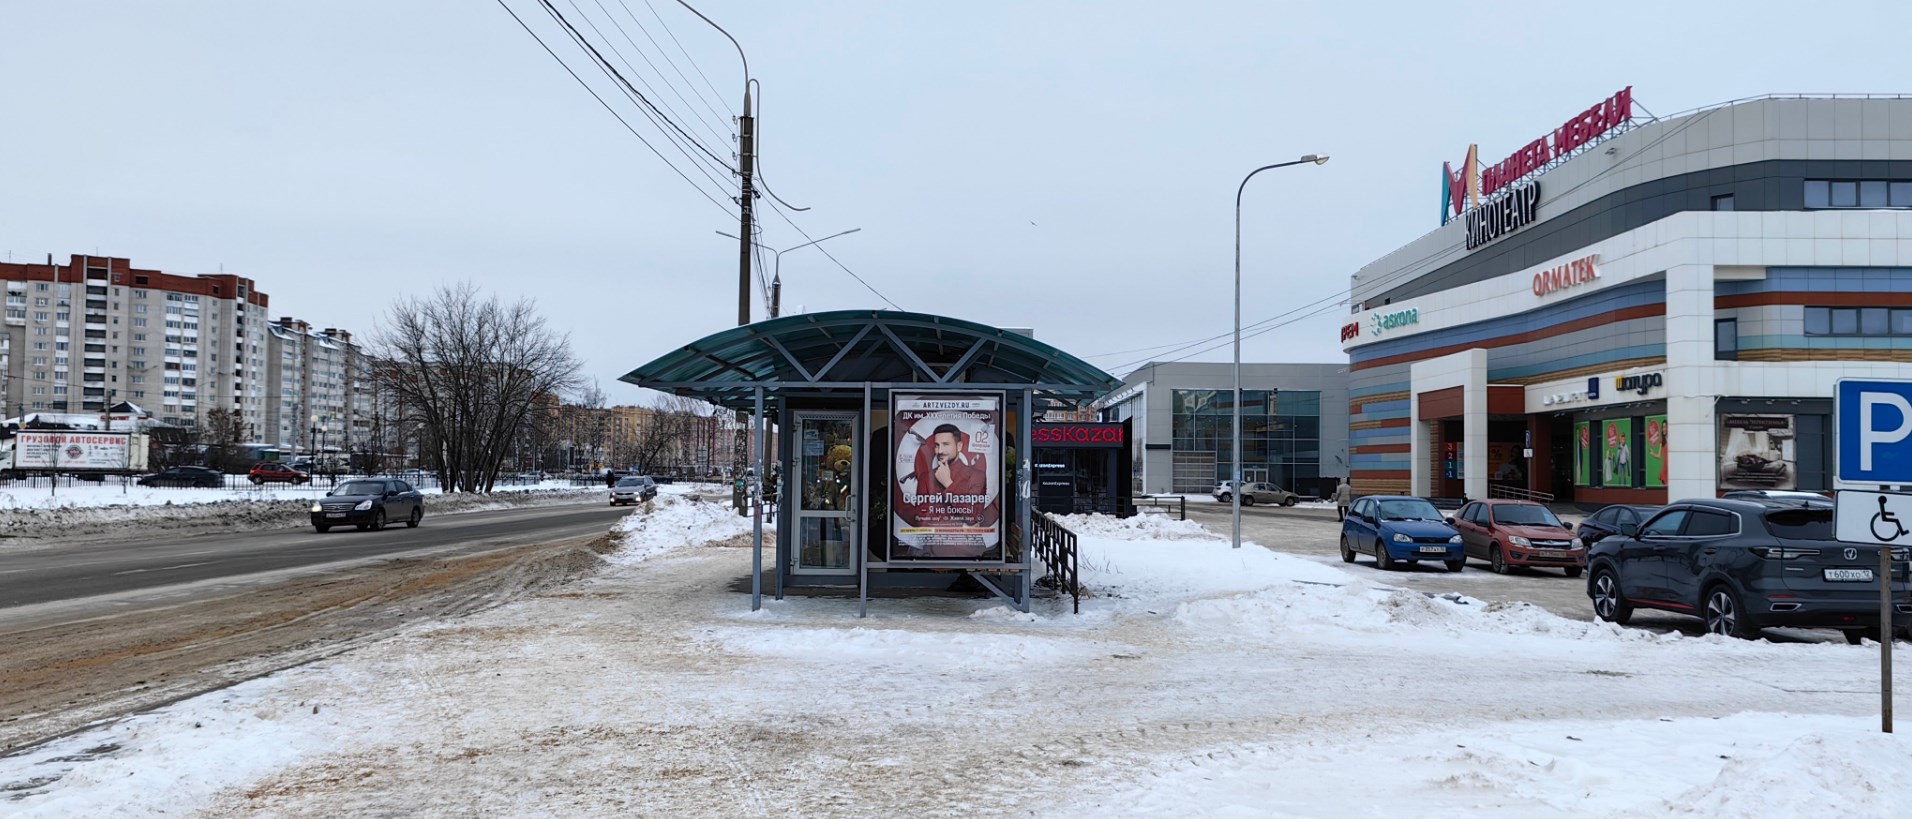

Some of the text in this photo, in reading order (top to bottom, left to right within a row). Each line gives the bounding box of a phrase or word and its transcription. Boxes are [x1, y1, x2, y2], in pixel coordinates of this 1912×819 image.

[1482, 85, 1633, 196] ПЛАНЕТА МЕБЕЛИ
[1465, 181, 1541, 250] КИНОТЕАТР
[1532, 254, 1598, 297] ORMATEK
[1383, 307, 1419, 329] askona
[922, 401, 970, 409] ARTZVEZDY.RU
[902, 412, 913, 420] ДК
[964, 412, 991, 420] Победы
[975, 431, 989, 444] 02
[1860, 391, 1912, 471] P
[69, 436, 126, 445] АВТОСЕРВИС
[902, 492, 991, 505] Сергей Лазарев
[928, 506, 934, 514] Я
[947, 505, 974, 514] боюсь!
